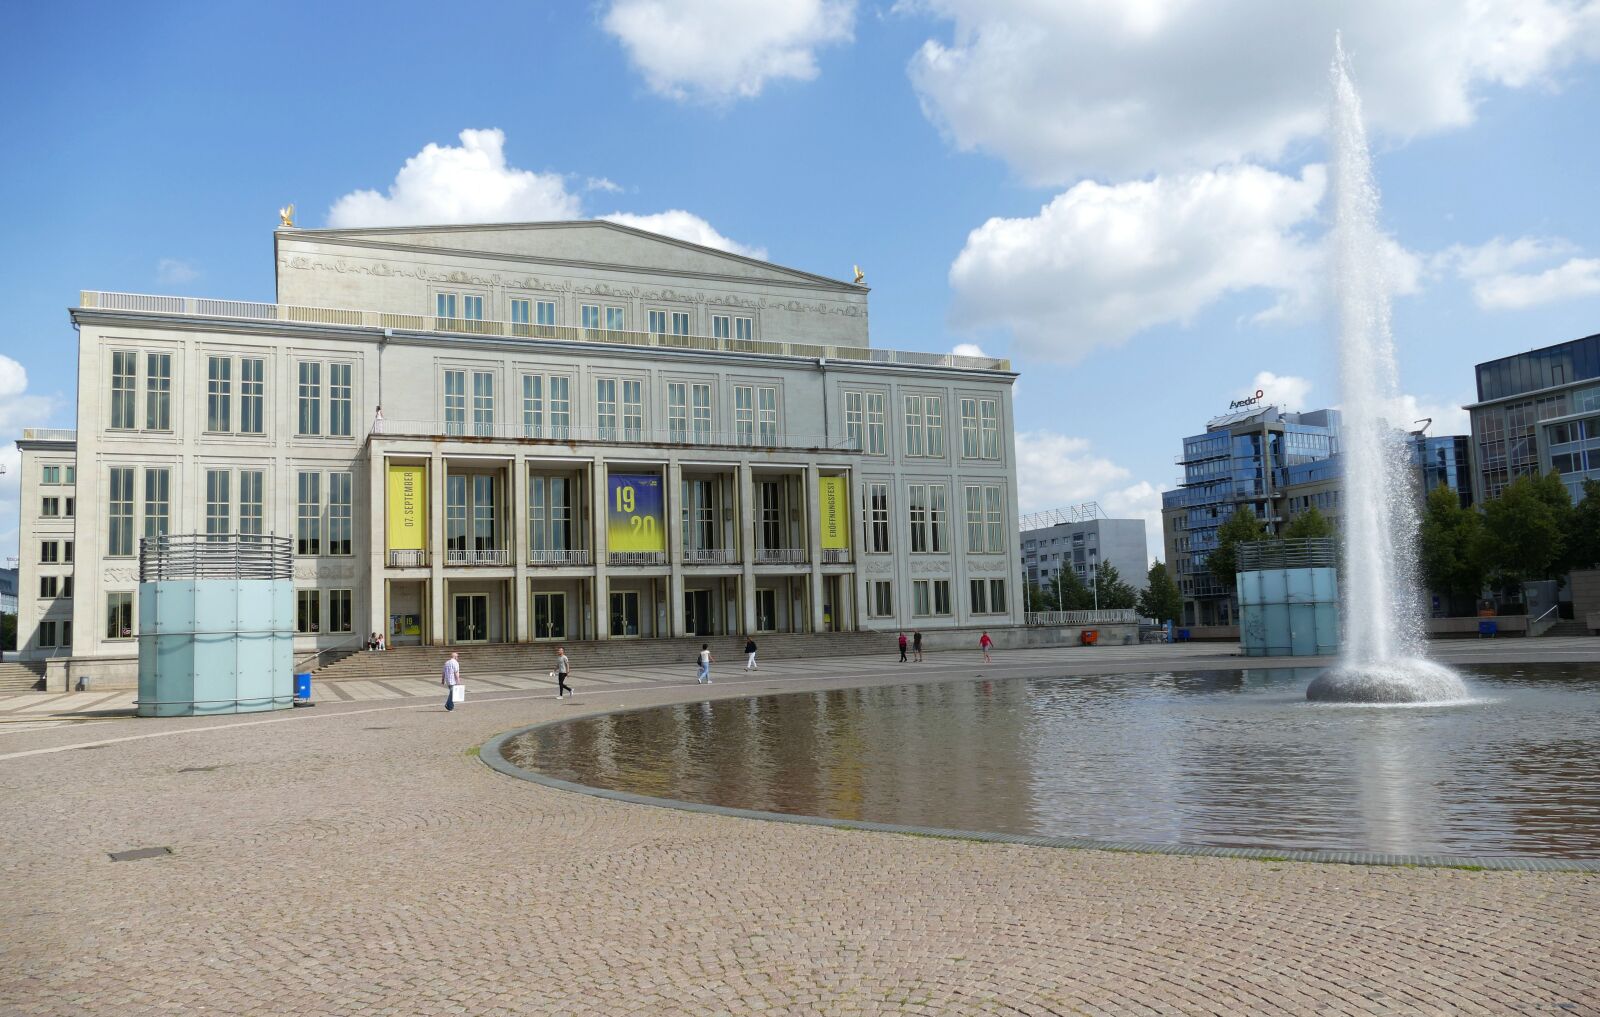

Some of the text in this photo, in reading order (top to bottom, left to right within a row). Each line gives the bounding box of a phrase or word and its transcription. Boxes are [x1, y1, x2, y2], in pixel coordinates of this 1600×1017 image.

[404, 472, 414, 527] 07. SEPTEMBER
[616, 486, 635, 513] 19
[827, 482, 837, 538] ERÖFFNUNGSFEST
[630, 515, 656, 537] 20
